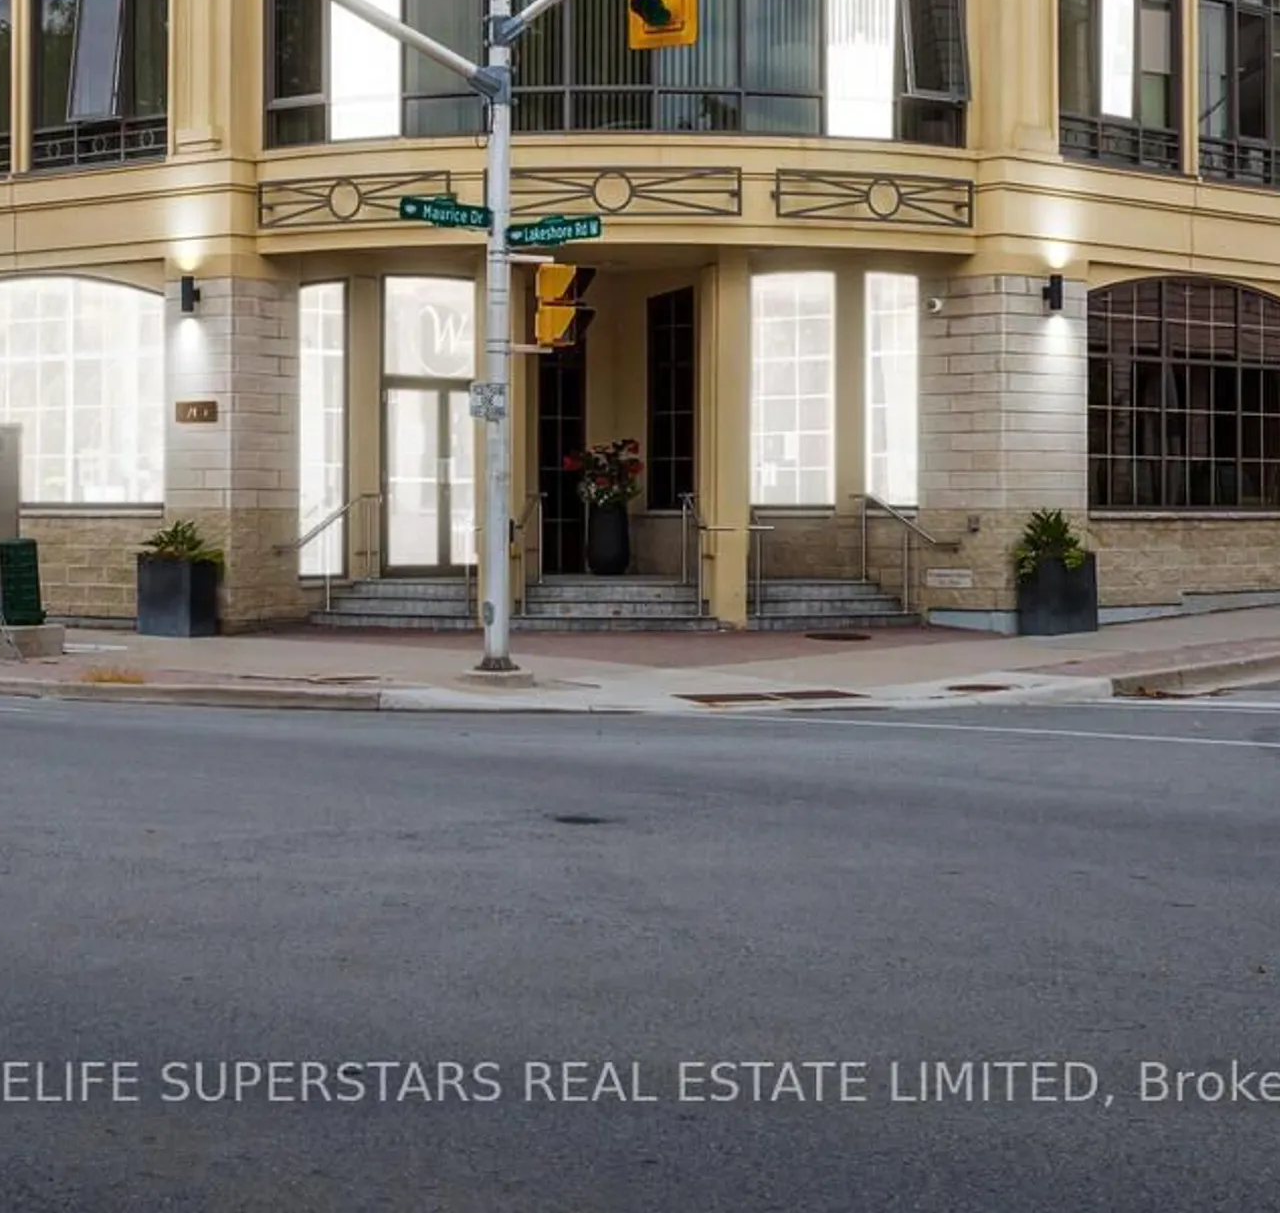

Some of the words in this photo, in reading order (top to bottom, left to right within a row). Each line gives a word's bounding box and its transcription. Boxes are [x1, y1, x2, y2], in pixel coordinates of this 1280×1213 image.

[423, 206, 467, 222] Maurice
[470, 210, 484, 225] Dr
[524, 223, 572, 241] Lakeshore
[575, 220, 588, 236] Rd
[589, 219, 598, 234] W
